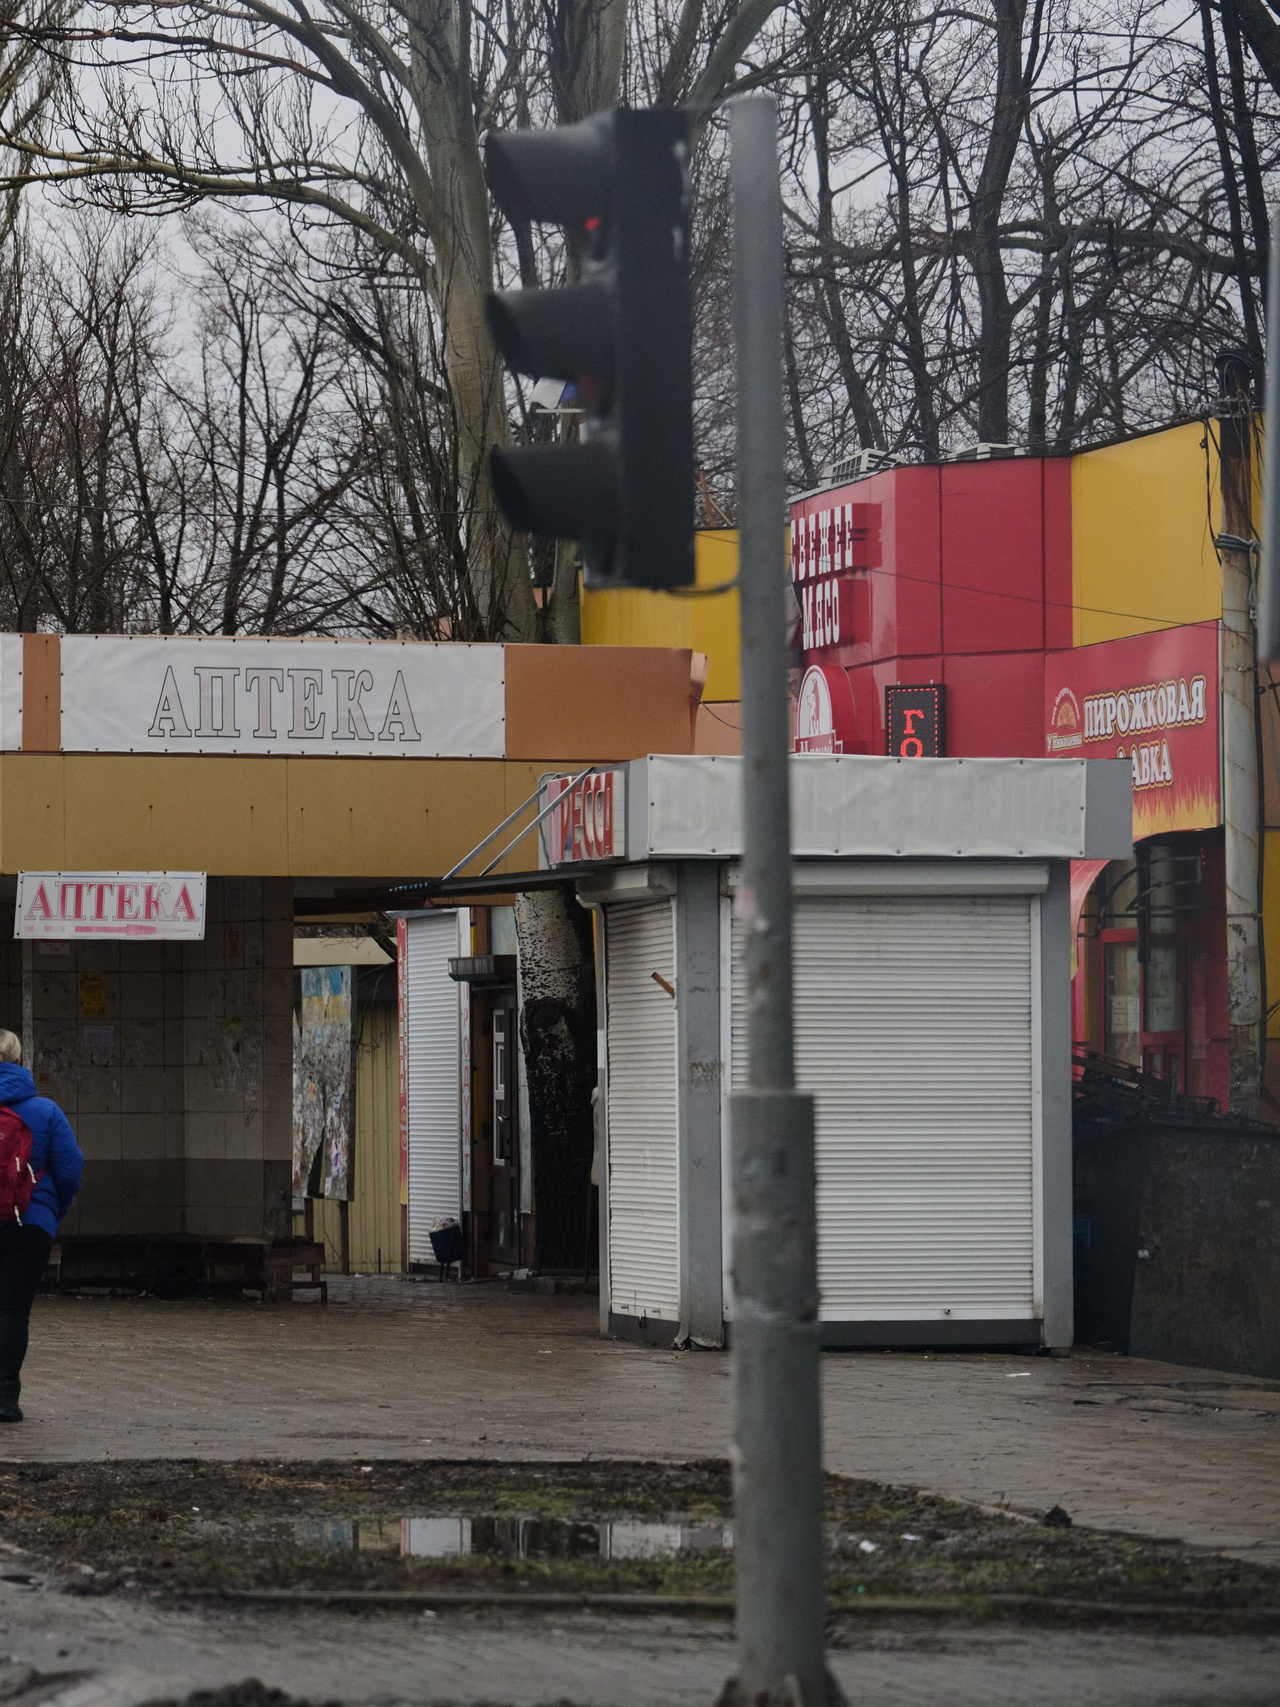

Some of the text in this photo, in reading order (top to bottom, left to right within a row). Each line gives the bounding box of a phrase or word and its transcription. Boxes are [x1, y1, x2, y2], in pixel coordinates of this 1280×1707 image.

[790, 502, 853, 583] СВЕЖЕЕ
[802, 577, 840, 651] МЯСО
[148, 665, 422, 743] АПТЕКА
[1083, 679, 1205, 738] ПИРОЖКОВАЯ
[1119, 742, 1172, 787] АВКА
[547, 771, 614, 865] ПРЕССА
[24, 880, 200, 922] АПТЕКА
